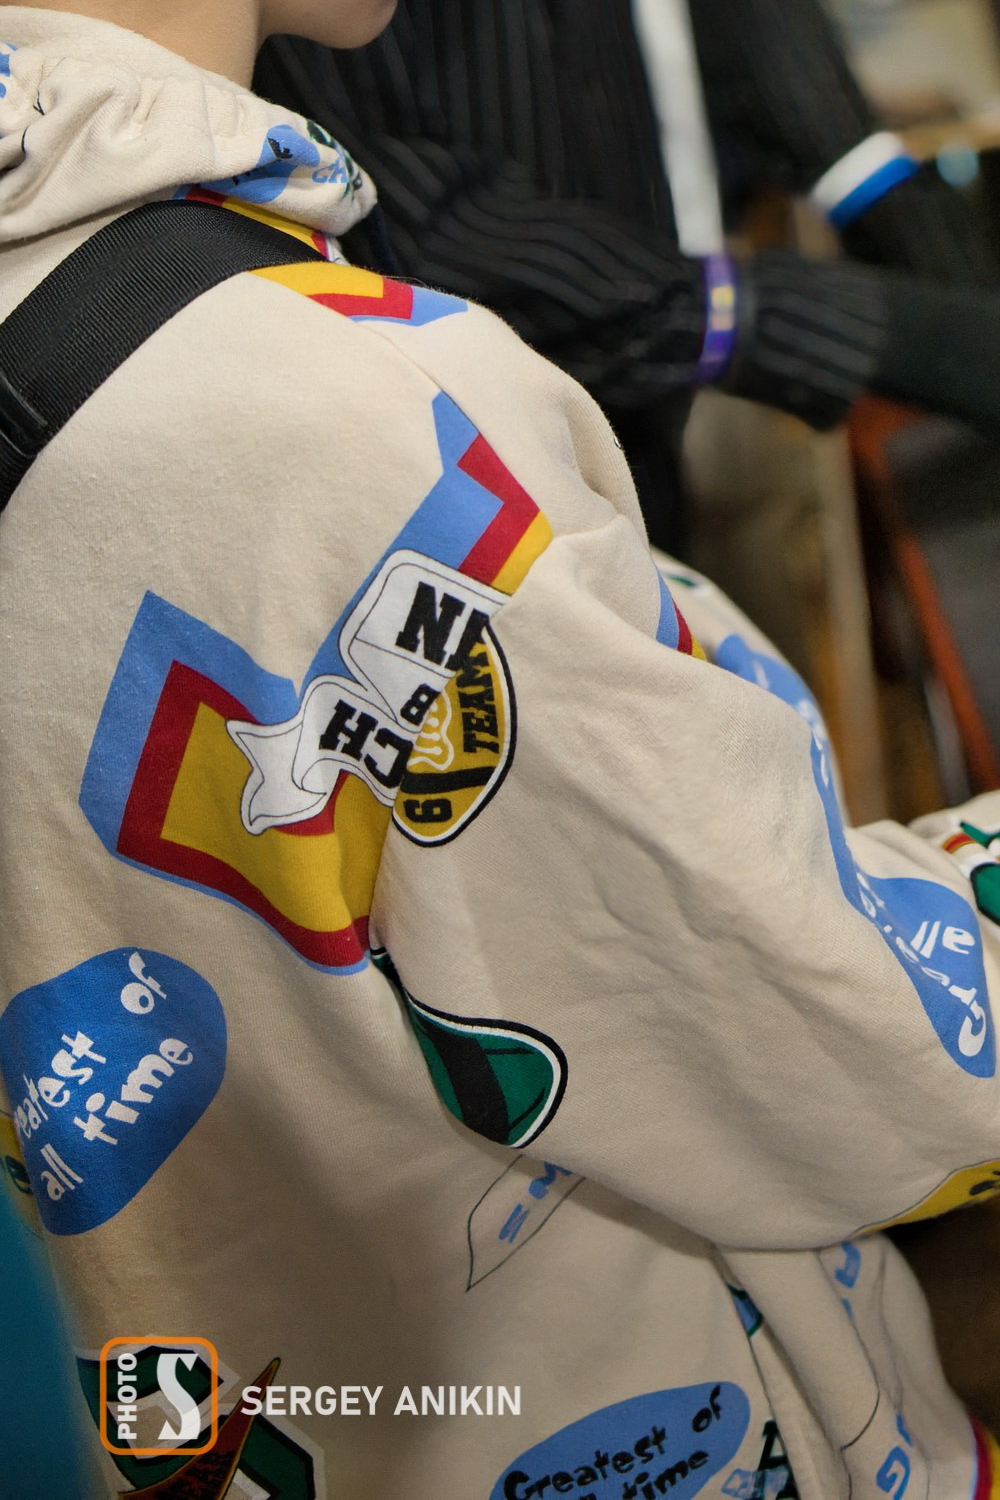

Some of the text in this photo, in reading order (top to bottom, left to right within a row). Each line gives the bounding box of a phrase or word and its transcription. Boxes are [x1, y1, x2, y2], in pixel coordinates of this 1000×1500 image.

[456, 648, 500, 755] TEAM
[121, 952, 167, 1014] of
[40, 1038, 193, 1201] all time
[504, 1384, 721, 1500] Greatest of
